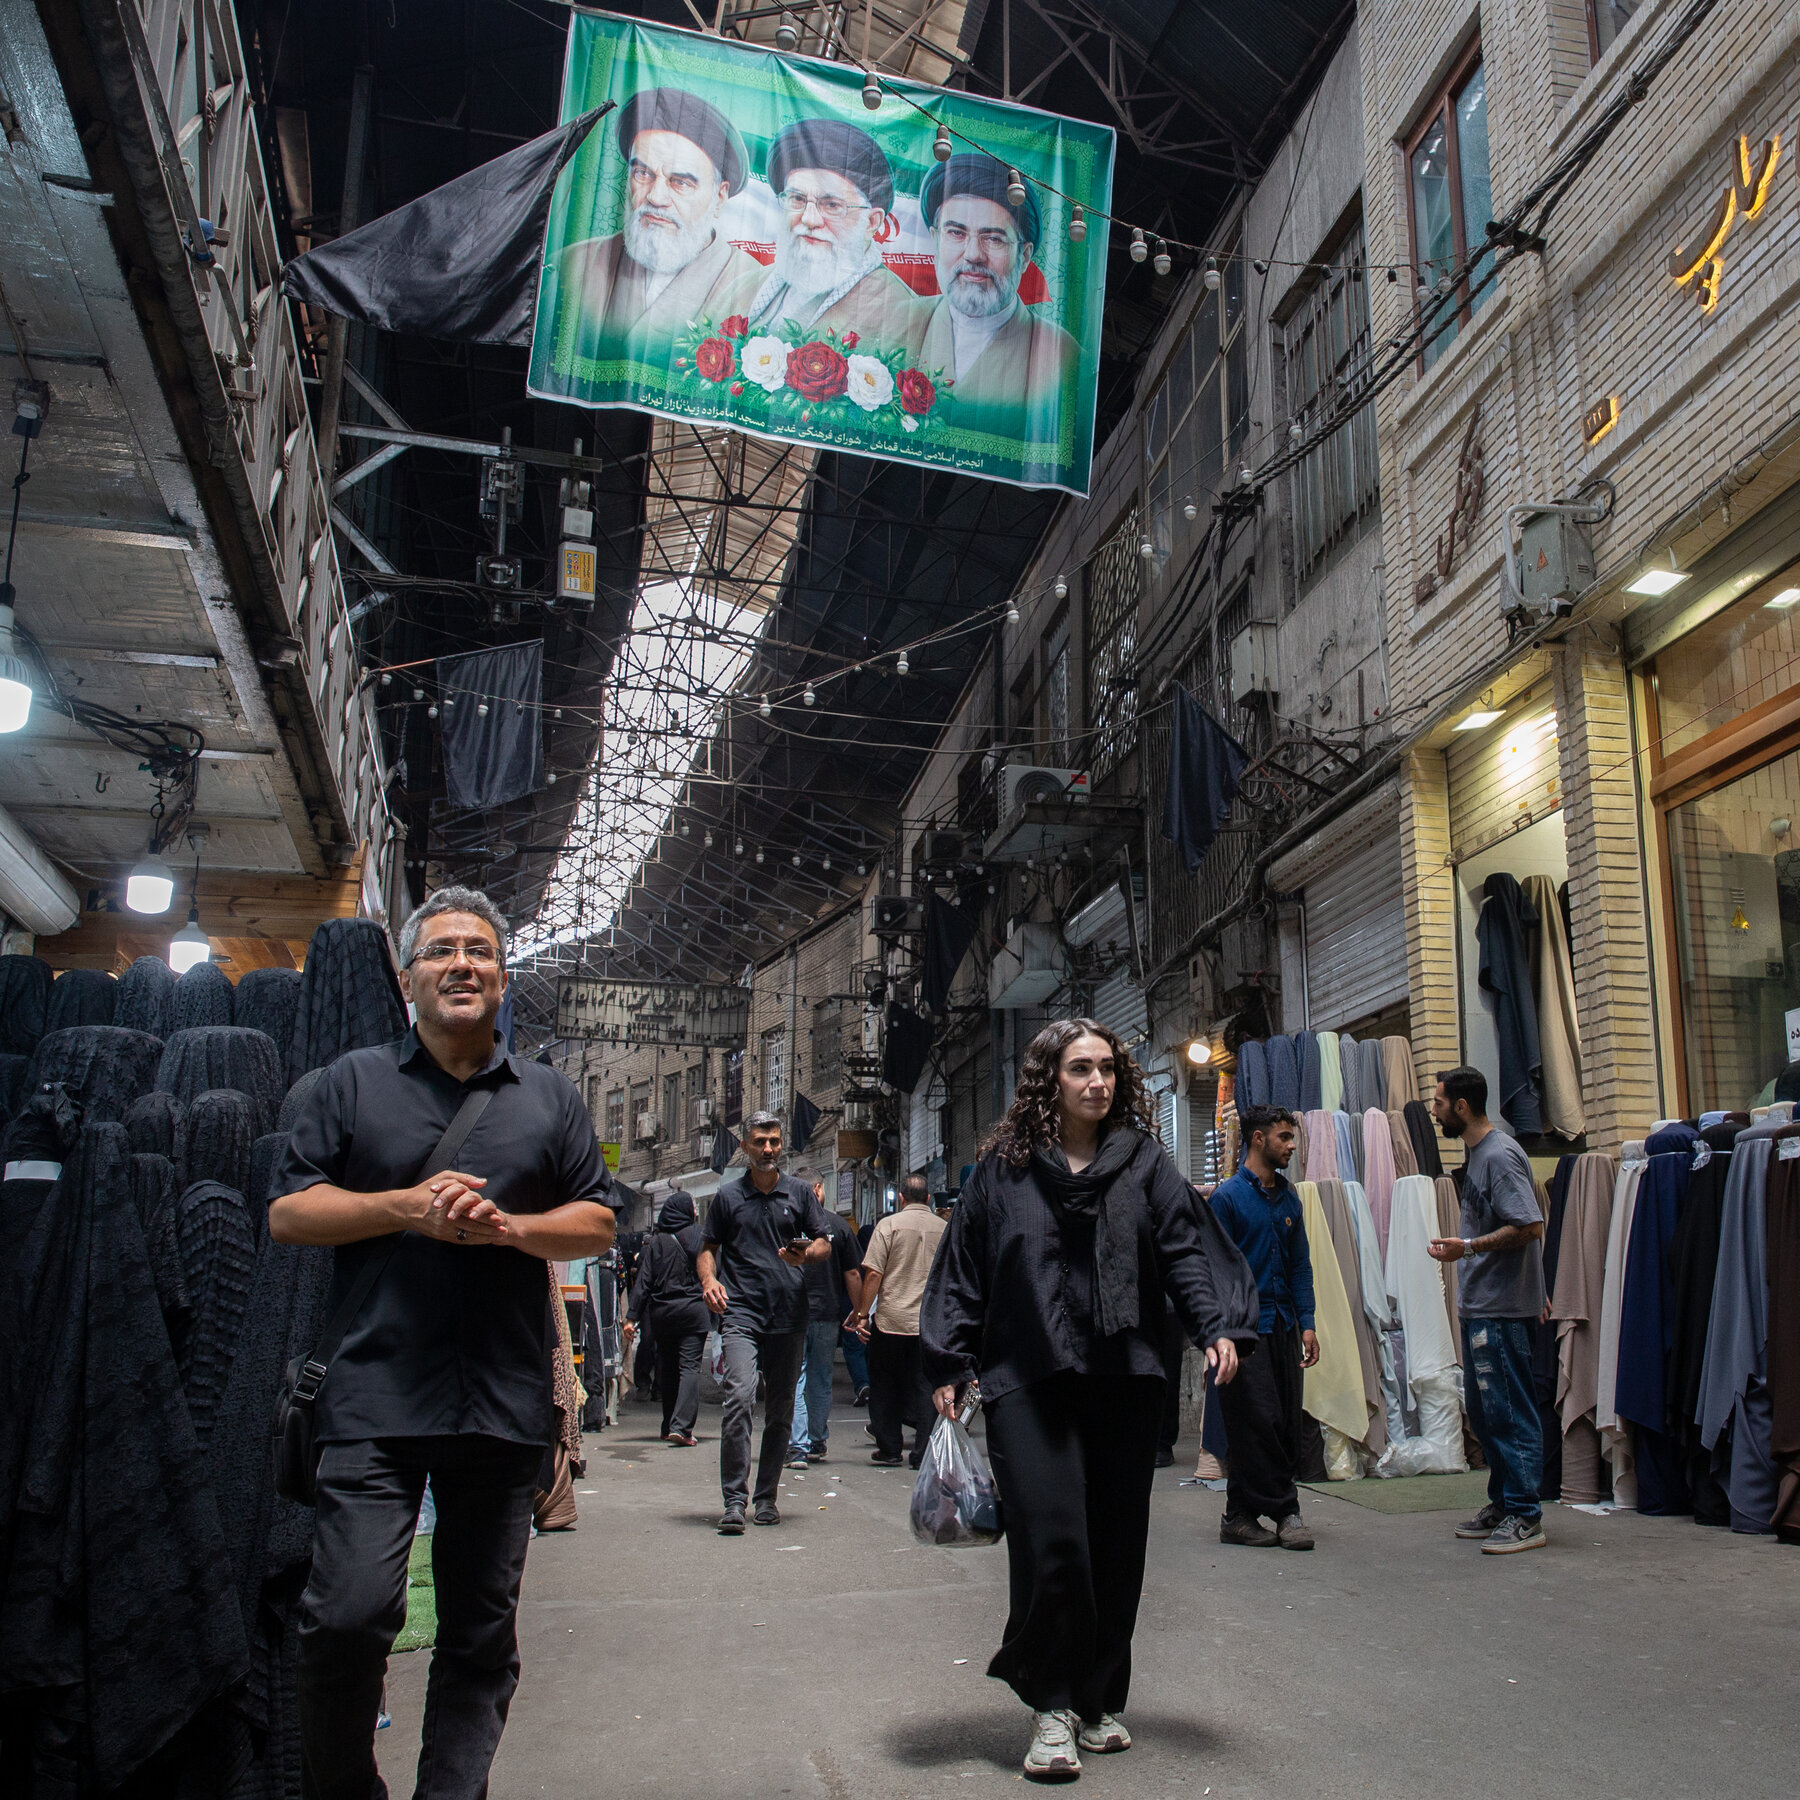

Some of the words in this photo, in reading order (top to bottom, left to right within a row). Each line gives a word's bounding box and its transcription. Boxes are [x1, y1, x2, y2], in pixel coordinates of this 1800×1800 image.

[639, 392, 663, 407] تهران
[663, 398, 683, 412] بازار
[701, 406, 737, 418] امامزاده
[738, 413, 766, 427] مسجد
[773, 424, 796, 434] غدیر
[798, 425, 833, 441] فرهنگی
[834, 432, 862, 446] شورای
[870, 440, 899, 451] قماش
[899, 444, 923, 457] صنف
[924, 451, 955, 462] اسلامی
[955, 458, 984, 469] انجمن
